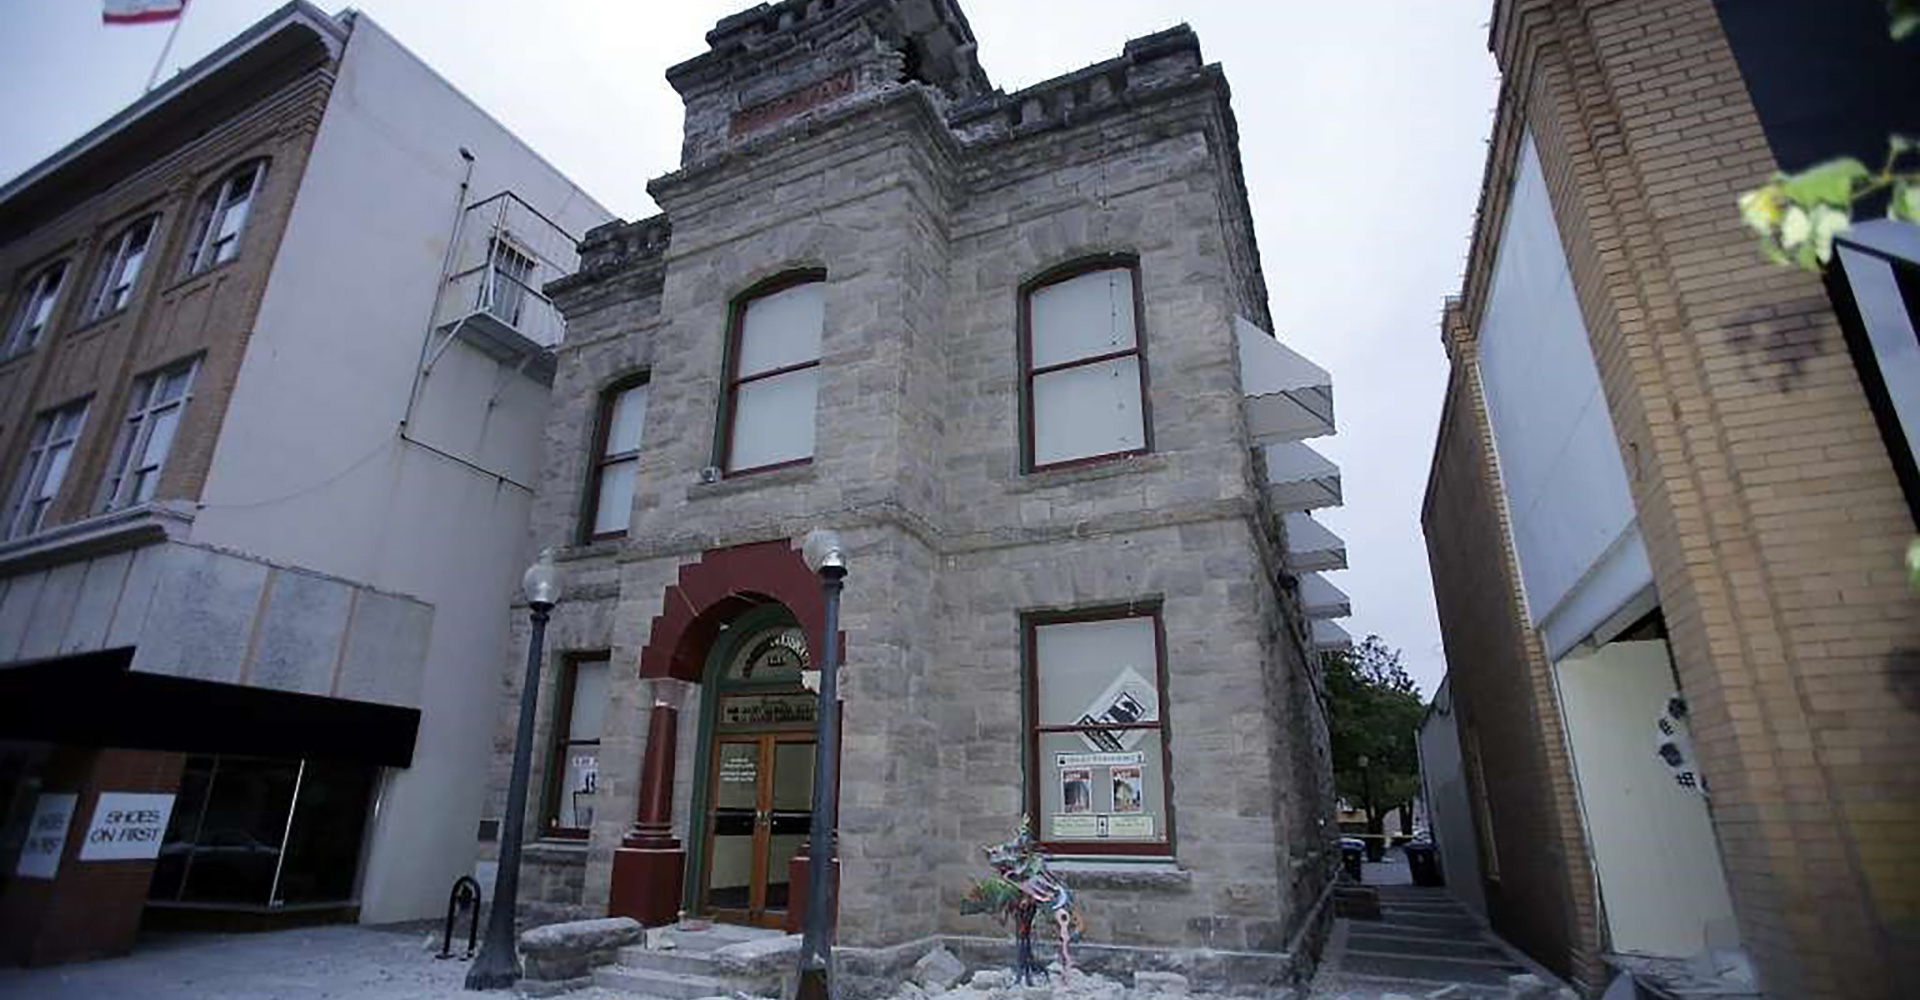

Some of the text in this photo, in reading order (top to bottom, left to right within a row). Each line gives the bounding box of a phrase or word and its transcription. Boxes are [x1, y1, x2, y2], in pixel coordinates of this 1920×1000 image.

[106, 810, 161, 824] SHOES
[90, 827, 161, 844] ON FIRST
